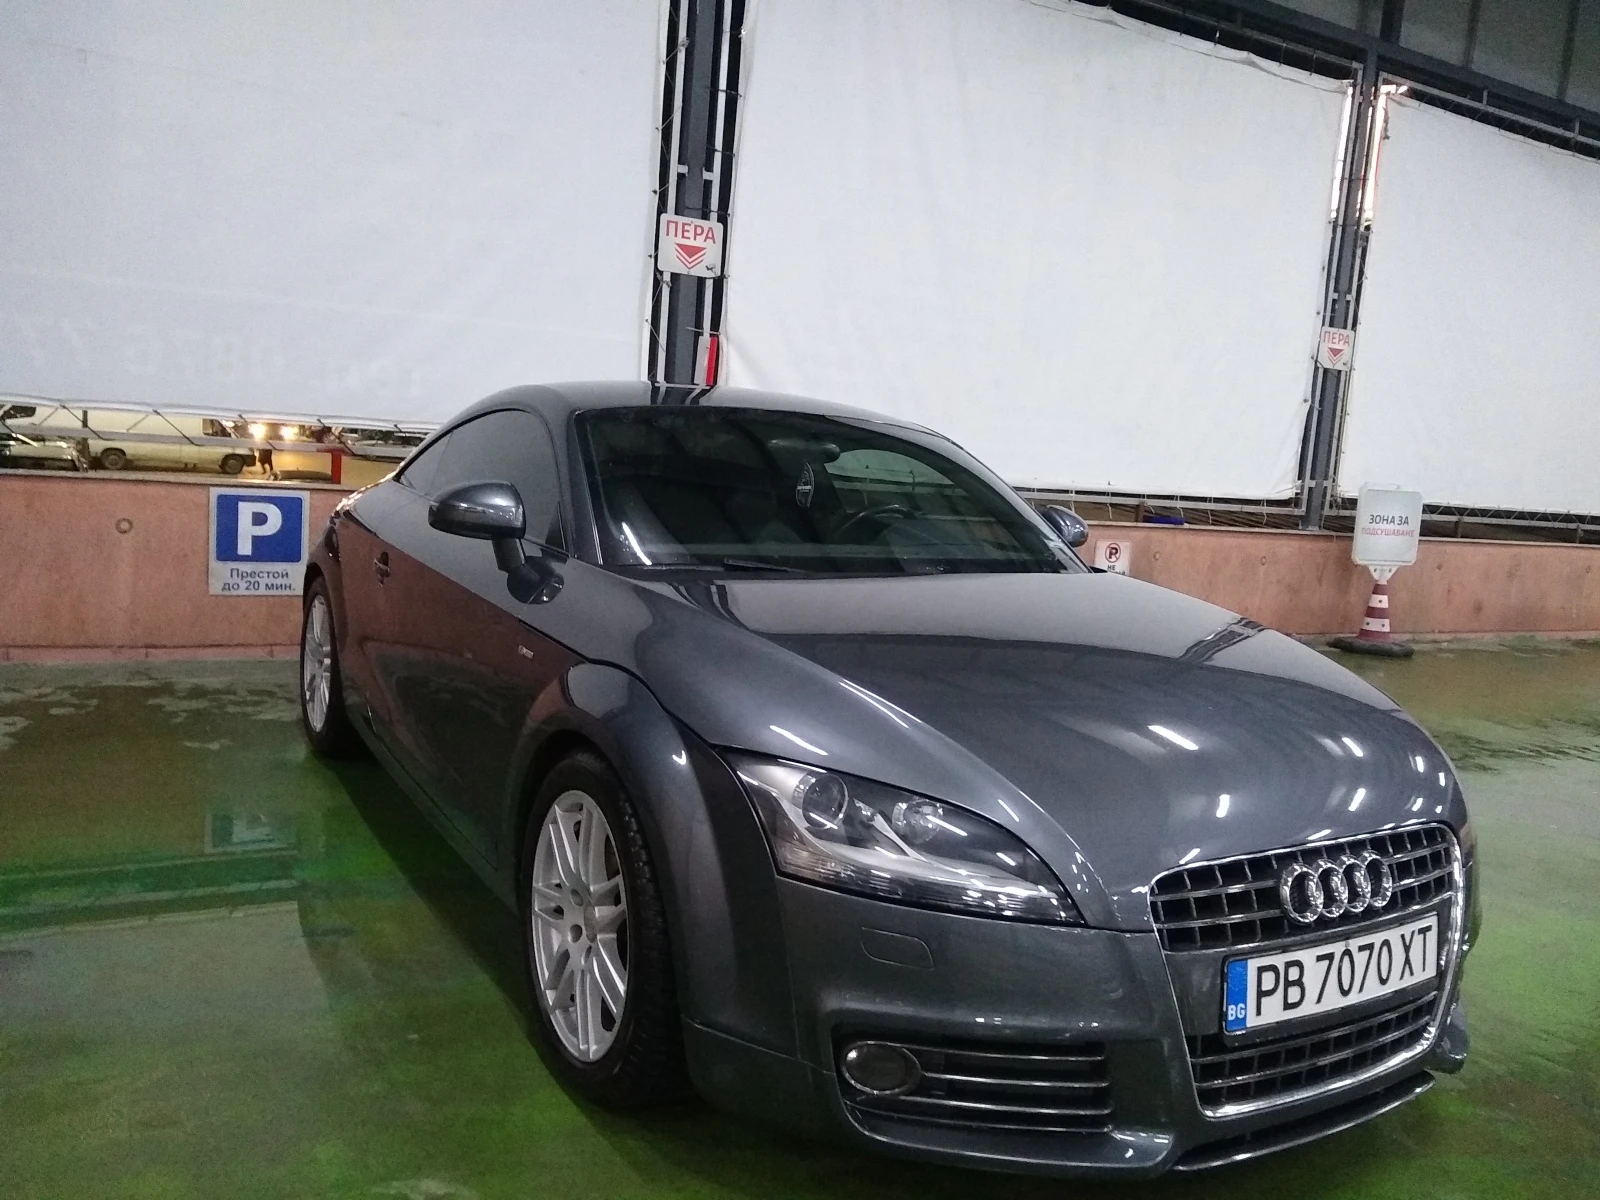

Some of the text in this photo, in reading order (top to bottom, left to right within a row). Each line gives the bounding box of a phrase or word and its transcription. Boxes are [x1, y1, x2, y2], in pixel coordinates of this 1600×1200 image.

[665, 219, 716, 245] ПЕРА
[1323, 330, 1350, 347] ПЕРА
[237, 500, 282, 556] P
[1368, 514, 1410, 526] ЗОНА ЗА
[1361, 527, 1416, 538] ПОДСУШАВАНЕ
[229, 567, 289, 581] Престой
[221, 580, 296, 592] до 20 мин.
[1255, 924, 1433, 1017] PB 7070 XT
[1227, 1003, 1246, 1021] BG
